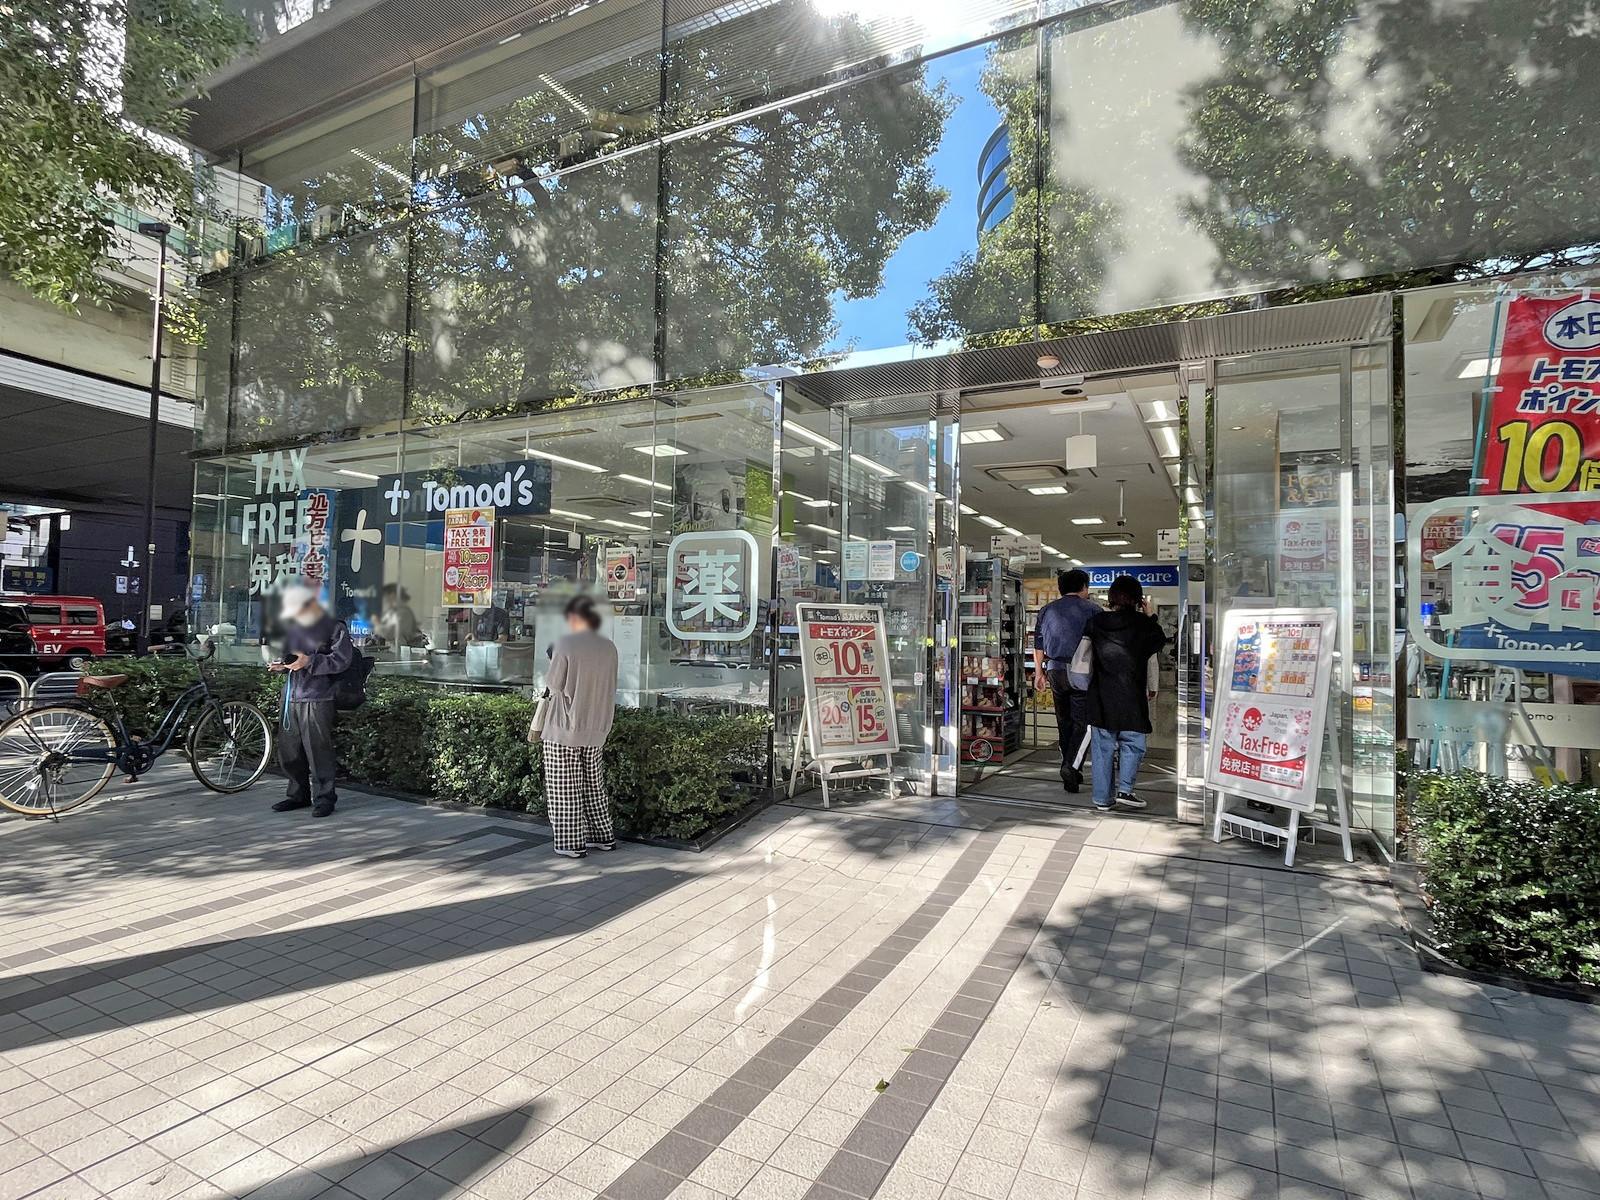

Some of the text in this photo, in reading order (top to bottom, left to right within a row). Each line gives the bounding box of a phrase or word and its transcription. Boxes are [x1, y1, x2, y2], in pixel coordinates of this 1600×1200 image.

[252, 447, 308, 495] TAX
[422, 464, 533, 512] Tomod's
[241, 499, 313, 546] FREE
[451, 538, 470, 547] FREE
[680, 549, 743, 623] 薬
[1137, 572, 1172, 583] care
[43, 644, 61, 653] EV
[1240, 732, 1288, 757] Tax-Free
[1221, 756, 1252, 775] 免税店
